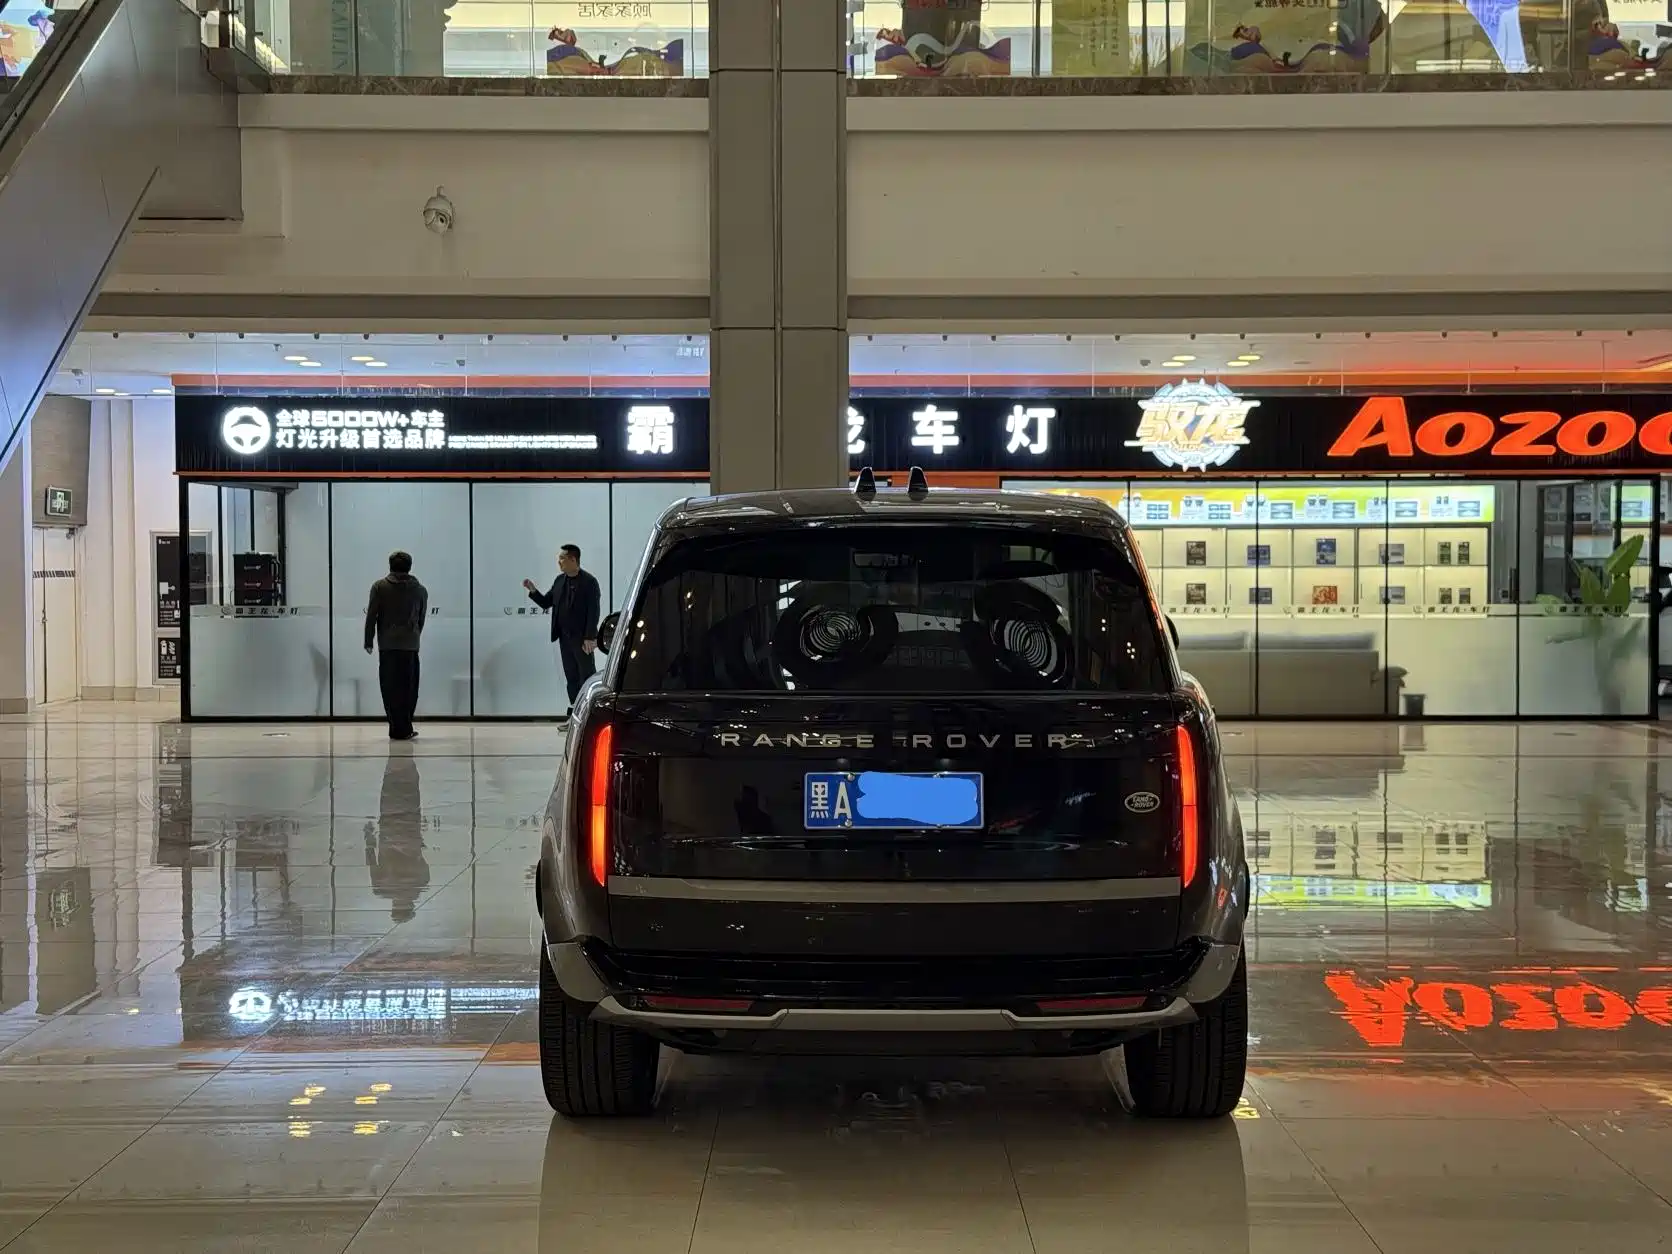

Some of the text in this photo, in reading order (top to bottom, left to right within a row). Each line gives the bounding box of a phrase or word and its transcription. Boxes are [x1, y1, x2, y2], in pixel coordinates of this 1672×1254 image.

[275, 428, 446, 449] 灯光升级首选品牌
[720, 732, 1068, 749] RANGE ROVER
